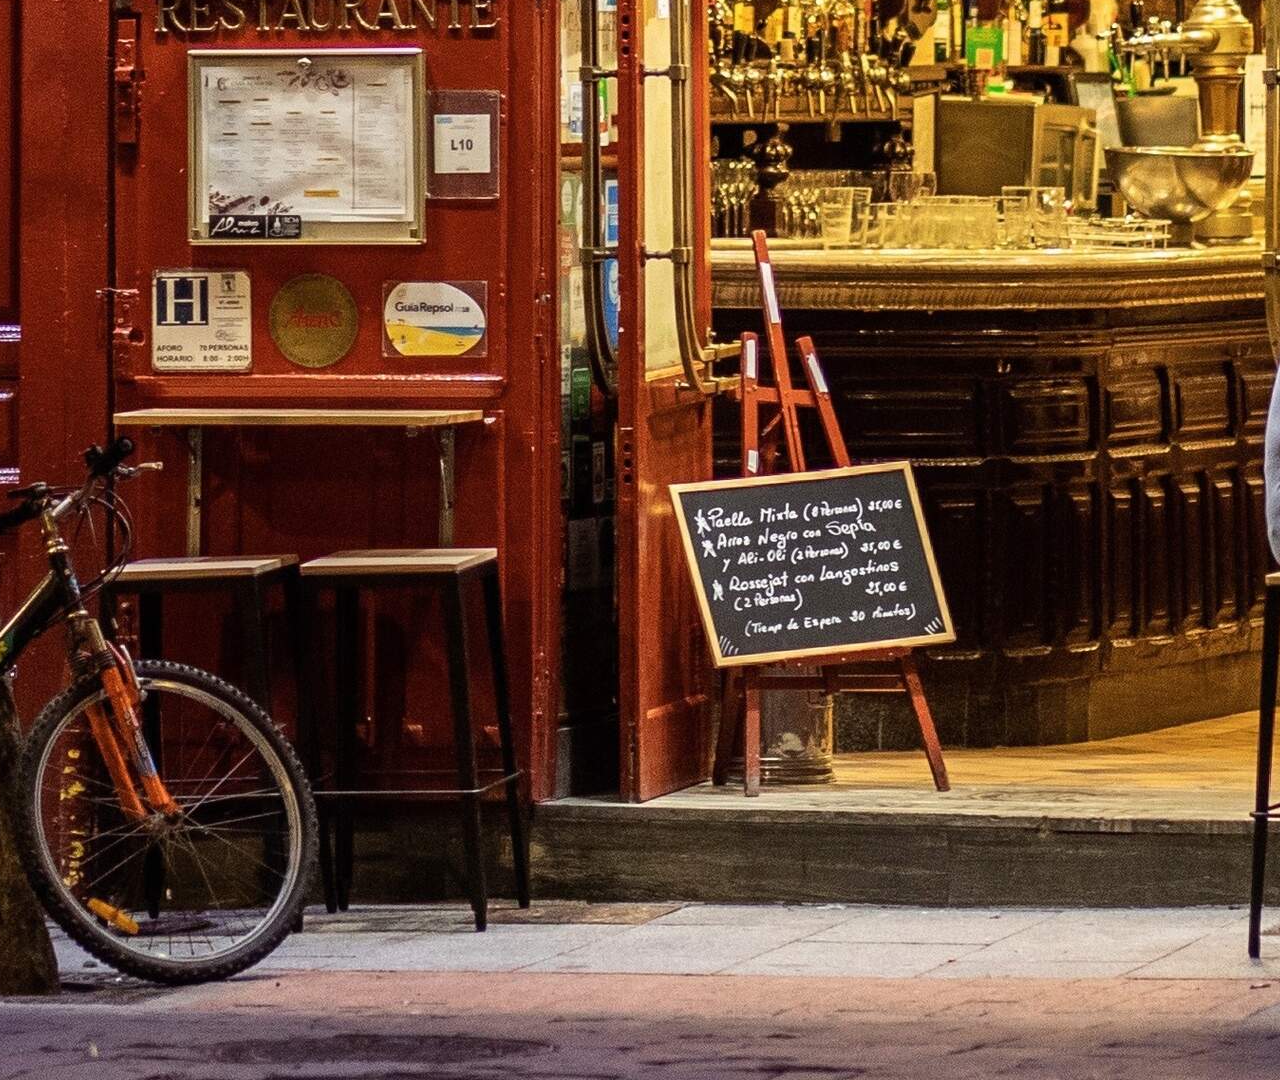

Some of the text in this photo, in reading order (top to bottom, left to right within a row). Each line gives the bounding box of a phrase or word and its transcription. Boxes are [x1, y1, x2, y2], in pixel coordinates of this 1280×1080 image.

[450, 139, 474, 151] L10
[419, 302, 453, 315] Repsol
[156, 344, 184, 352] AFORO
[208, 344, 249, 352] PERSONAS
[707, 506, 753, 528] Paella
[760, 502, 798, 523] Mixta
[758, 527, 798, 550] Negro
[802, 529, 821, 539] con
[729, 559, 899, 597] Rossejat con Langostinos
[803, 616, 842, 630] Espera
